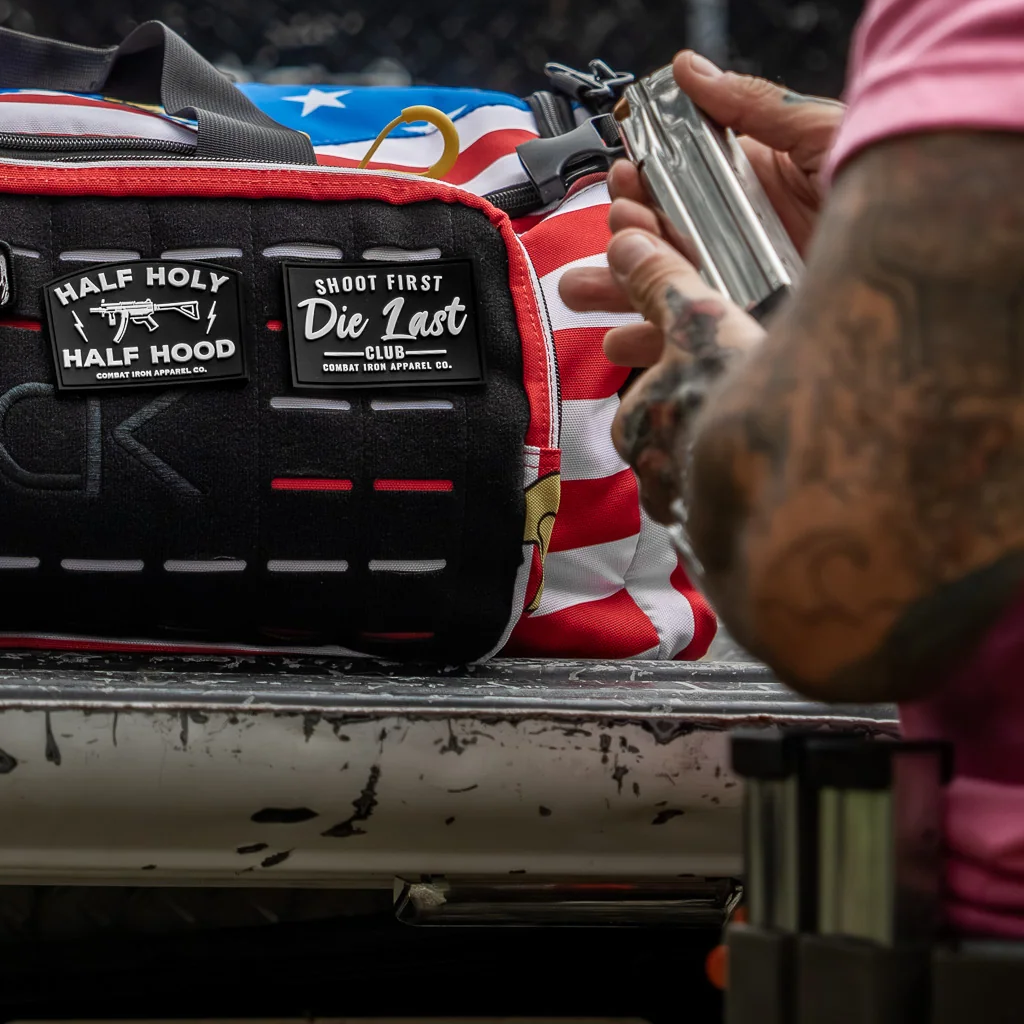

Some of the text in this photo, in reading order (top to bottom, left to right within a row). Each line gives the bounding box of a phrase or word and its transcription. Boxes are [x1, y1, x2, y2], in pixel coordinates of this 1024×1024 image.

[54, 266, 229, 306] HALF HOLY
[315, 274, 443, 295] SHOOT FIRST
[297, 296, 467, 341] Die Last
[62, 339, 236, 369] HALF HOOD
[365, 345, 405, 360] CLUB
[96, 372, 130, 380] COMBAT
[132, 370, 152, 378] IRON
[153, 367, 192, 377] APPAREL
[322, 361, 452, 372] COMBAT IRON APPAREL CO.
